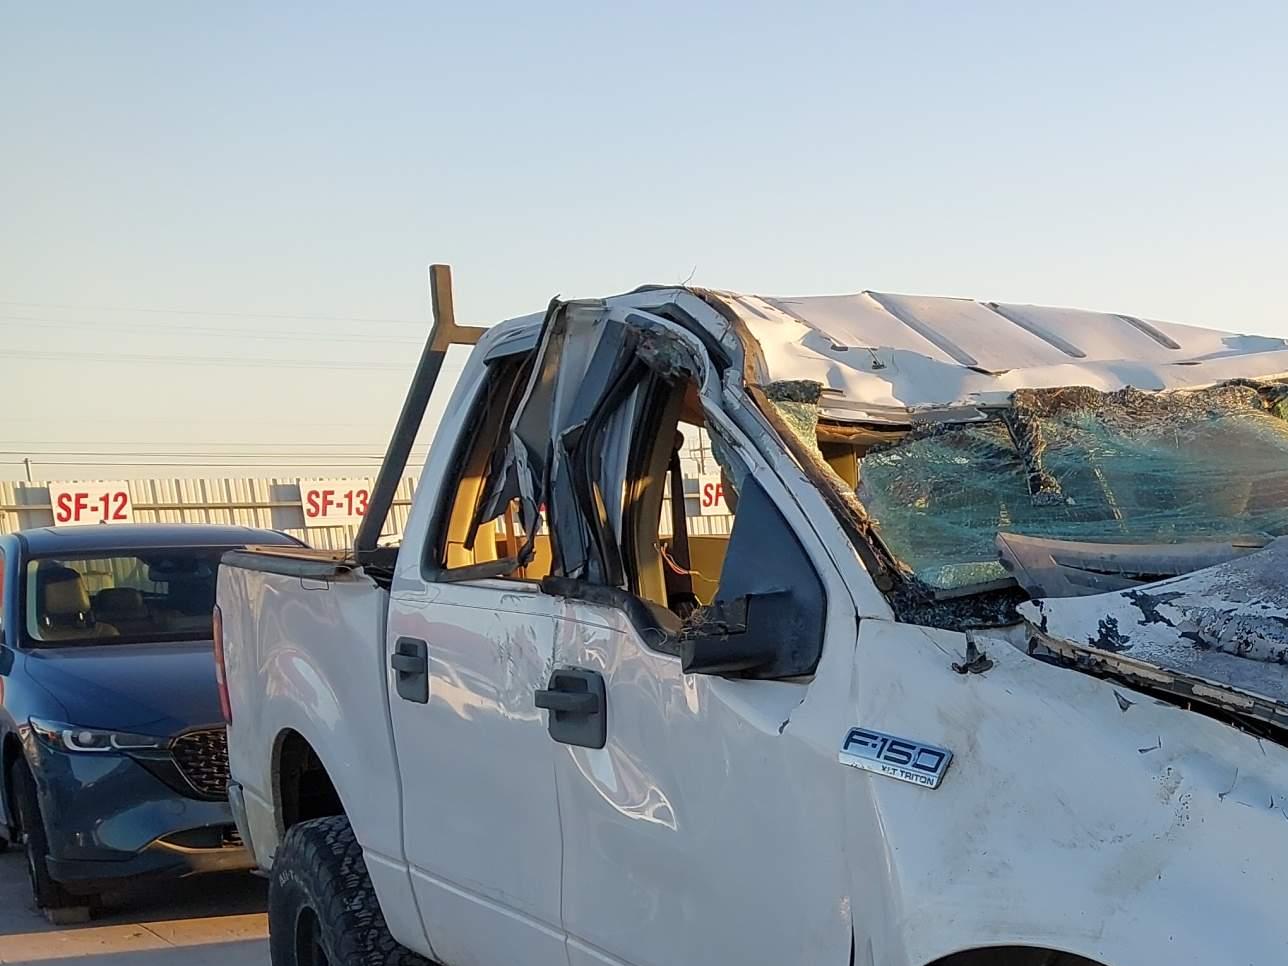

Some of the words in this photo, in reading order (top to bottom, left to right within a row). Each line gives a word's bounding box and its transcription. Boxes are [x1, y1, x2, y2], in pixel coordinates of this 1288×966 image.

[56, 490, 129, 523] SF-12
[305, 489, 369, 518] SF-13
[899, 769, 935, 786] TRITON
